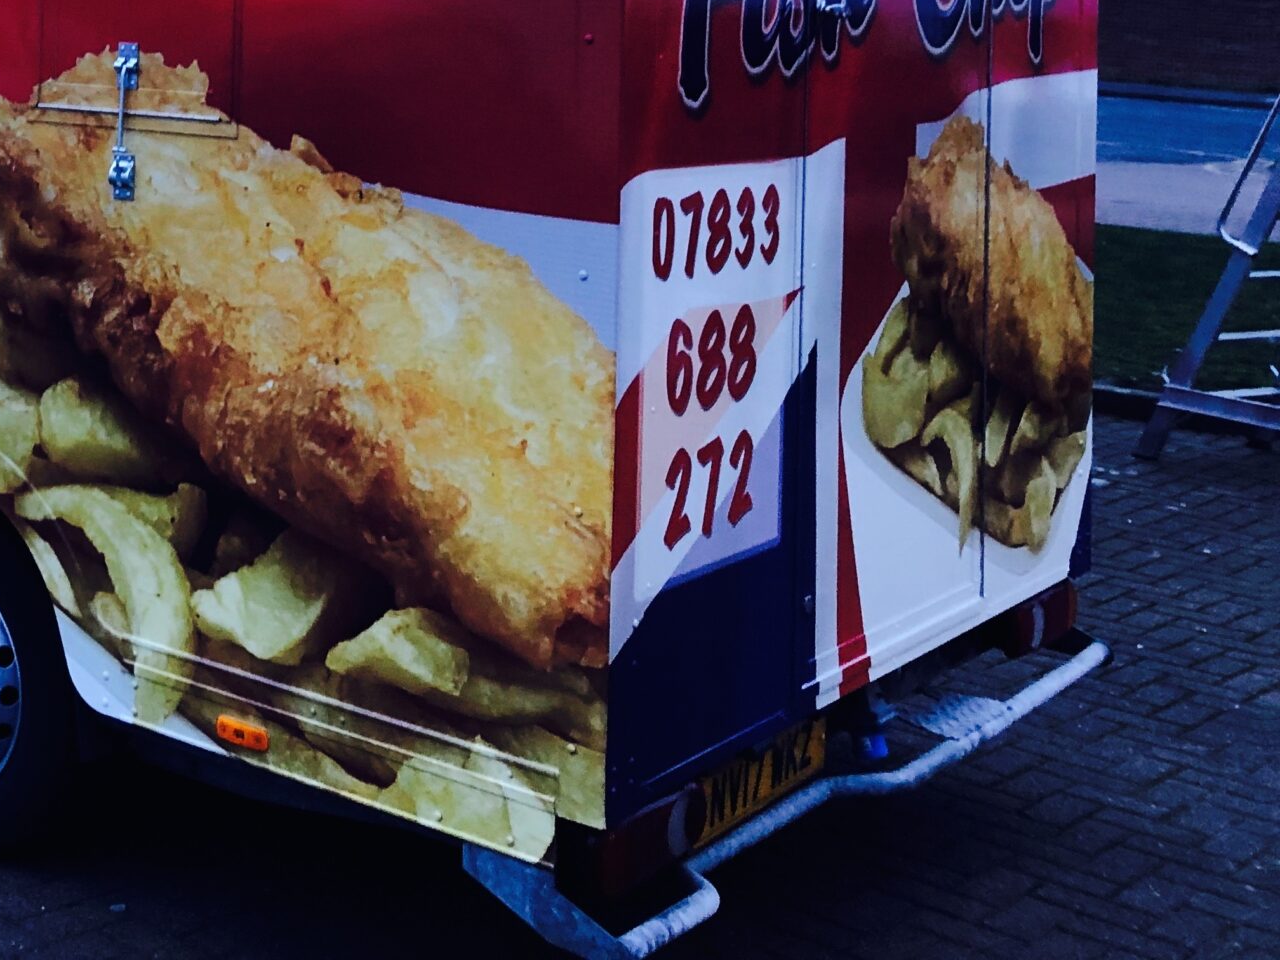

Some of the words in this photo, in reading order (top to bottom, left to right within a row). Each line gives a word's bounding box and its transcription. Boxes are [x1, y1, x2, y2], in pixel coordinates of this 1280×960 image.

[651, 182, 780, 282] 07833
[666, 303, 757, 418] 688
[664, 429, 754, 551] 272
